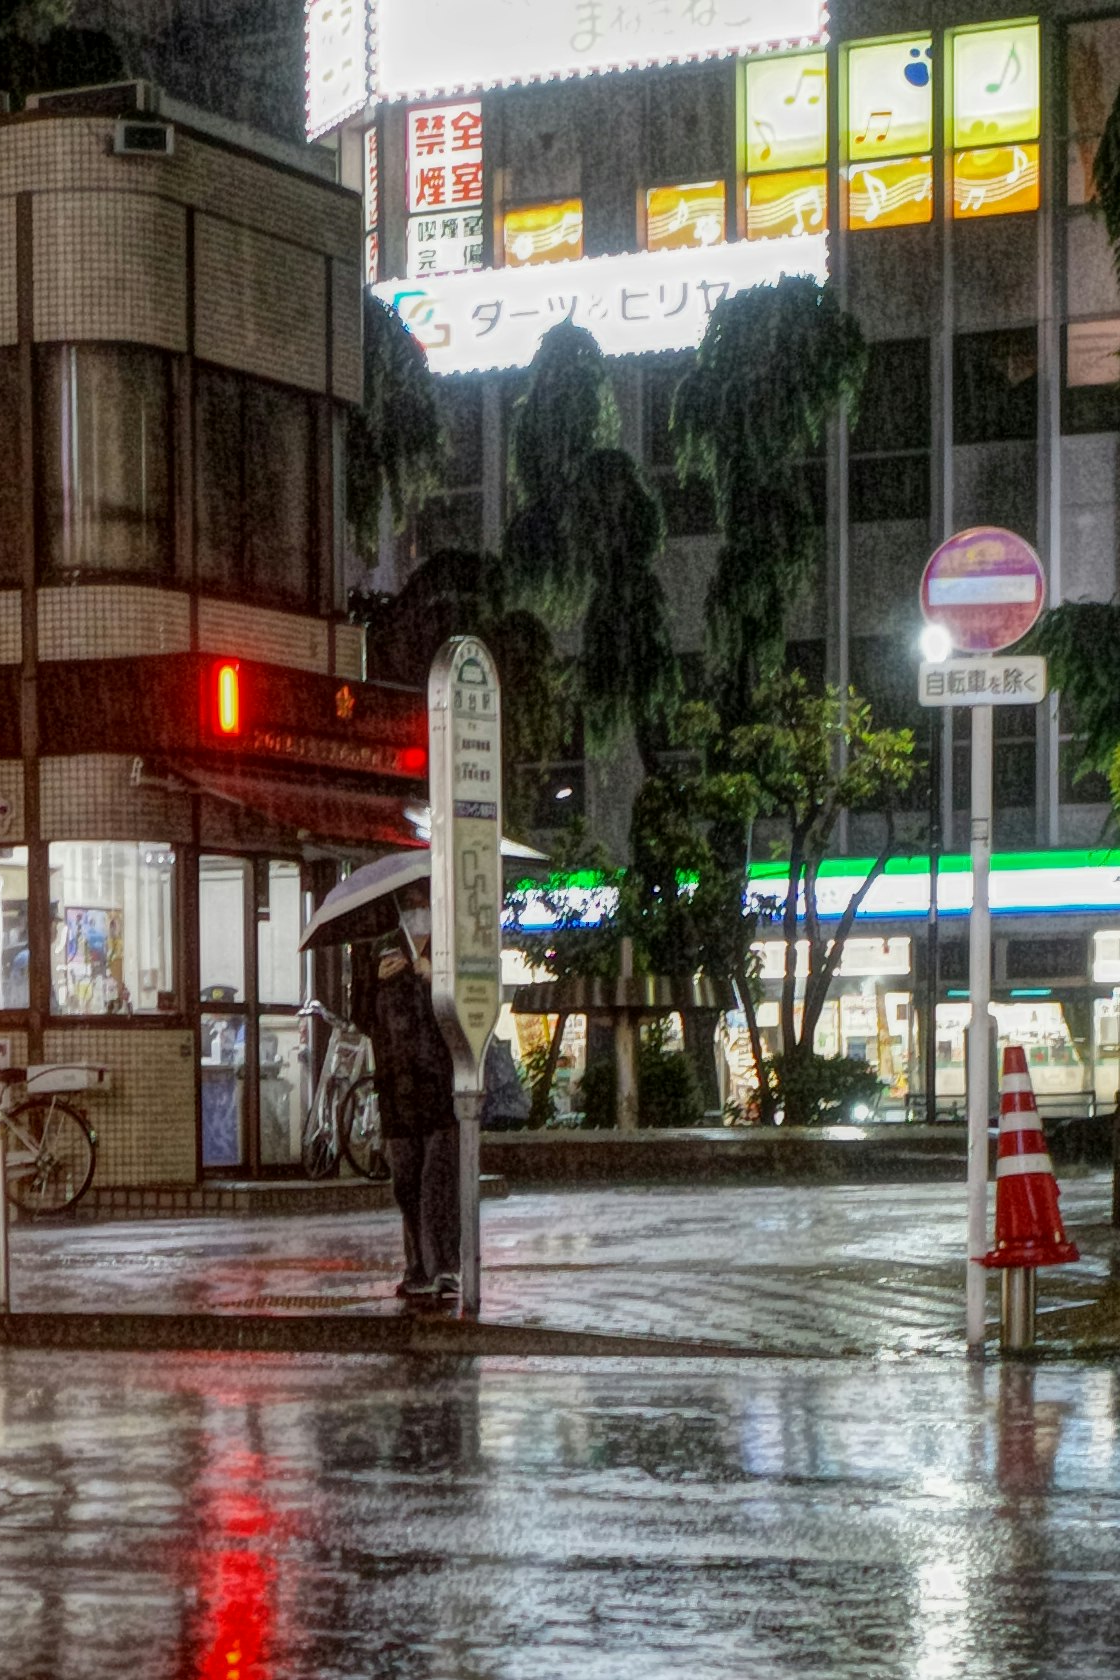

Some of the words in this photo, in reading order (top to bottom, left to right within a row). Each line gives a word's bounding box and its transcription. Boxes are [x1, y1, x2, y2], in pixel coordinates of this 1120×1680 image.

[926, 668, 1037, 696] 自転車を除く
